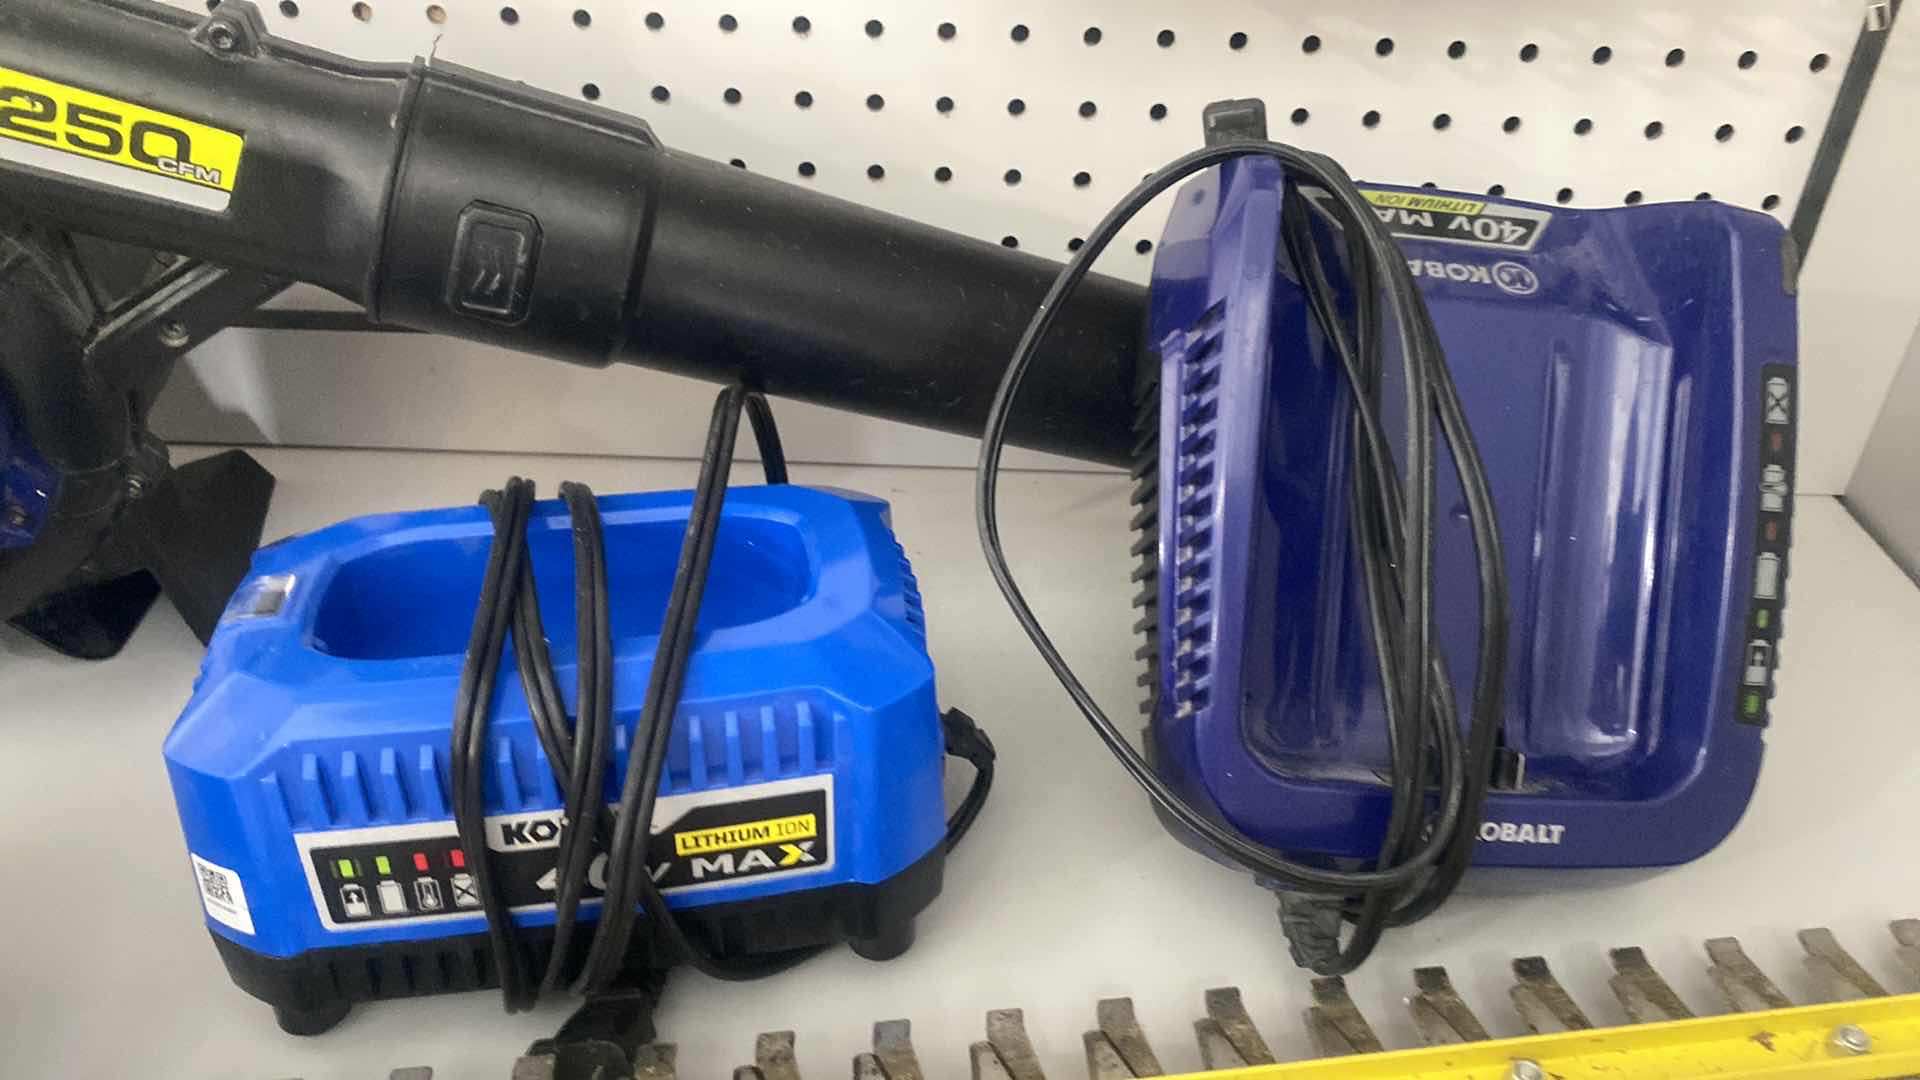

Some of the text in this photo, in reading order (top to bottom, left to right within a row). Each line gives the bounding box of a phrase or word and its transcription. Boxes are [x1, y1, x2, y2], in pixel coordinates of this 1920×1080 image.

[0, 86, 222, 185] 250 CFM
[1407, 194, 1478, 213] LITHIUM
[1371, 207, 1435, 228] MA
[1407, 259, 1493, 284] KOBA
[681, 818, 810, 851] LITHIUM ION
[1475, 821, 1566, 844] OBALT
[691, 840, 817, 879] MAX
